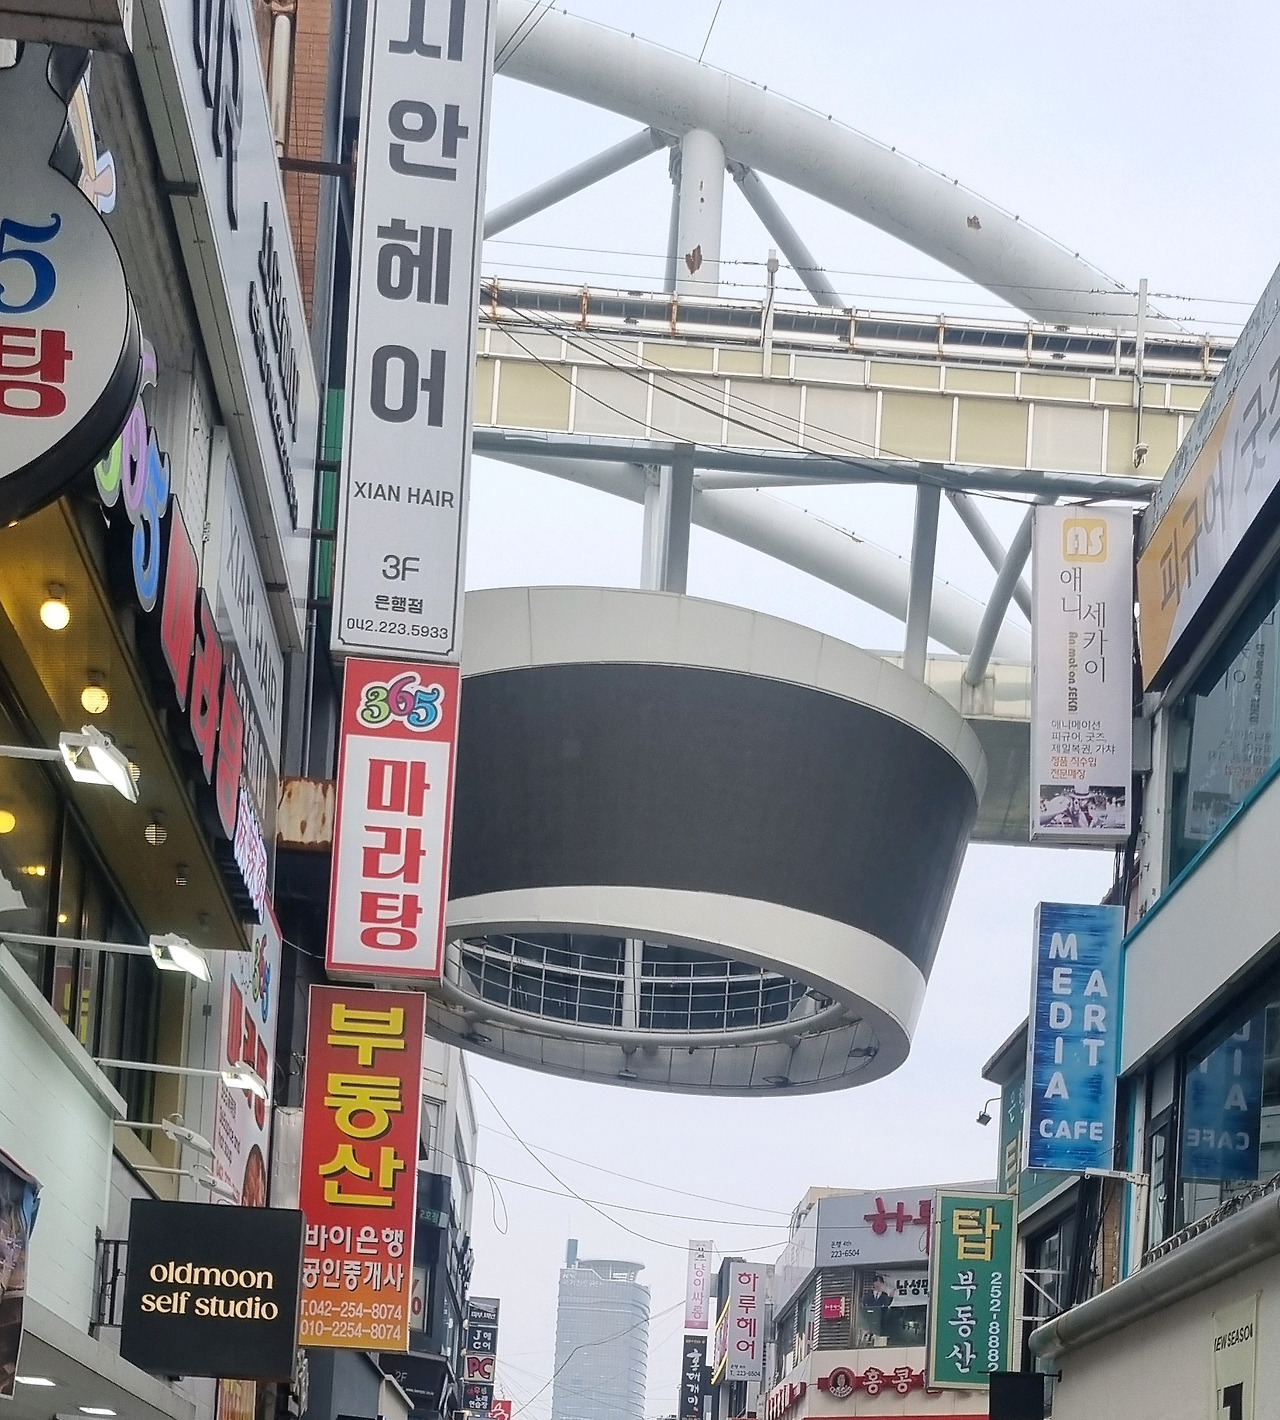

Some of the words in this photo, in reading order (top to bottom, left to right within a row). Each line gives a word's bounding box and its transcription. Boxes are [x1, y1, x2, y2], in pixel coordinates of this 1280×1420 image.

[354, 481, 400, 502] XIAN
[407, 486, 455, 508] HAIR
[382, 554, 420, 581] 3F
[374, 594, 423, 614] 은행점
[346, 617, 449, 640] 042.223.5933
[360, 675, 440, 728] 365
[1051, 720, 1101, 730] 애니메이션
[360, 758, 431, 951] 마라탕
[1043, 932, 1078, 1100] MEDIA
[1083, 969, 1108, 1067] ART
[318, 1003, 405, 1207] 부동산
[1039, 1118, 1104, 1141] CAFE
[953, 1206, 1001, 1261] 탑
[830, 1249, 860, 1258] 223-6504
[150, 1261, 274, 1290] oldmoon
[303, 1258, 403, 1292] 공인중개사
[140, 1291, 189, 1315] self
[195, 1294, 279, 1321] studio
[737, 1272, 759, 1360] 하루헤어
[945, 1269, 977, 1374] 부동산
[467, 1357, 494, 1380] PC
